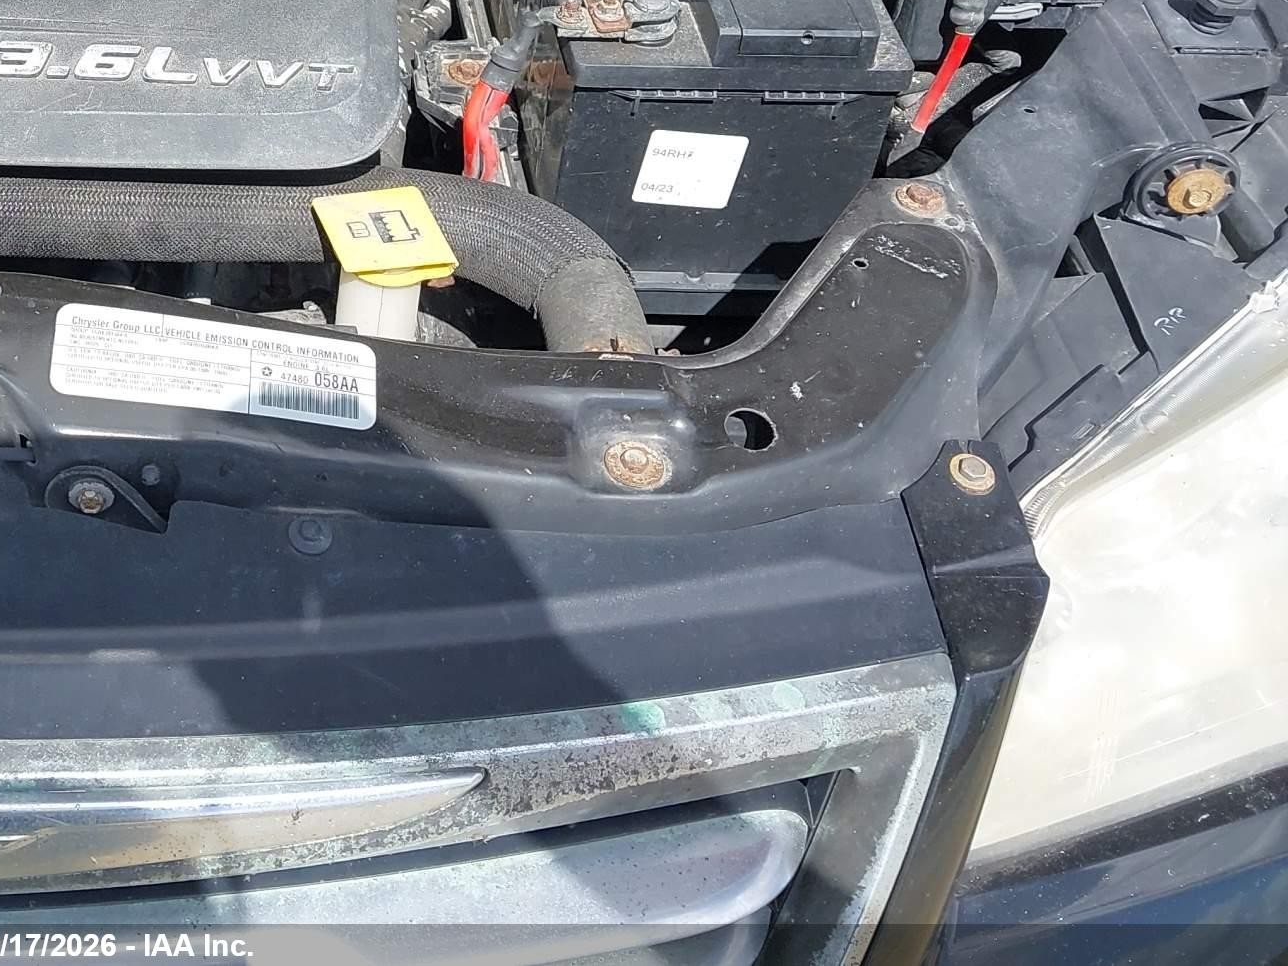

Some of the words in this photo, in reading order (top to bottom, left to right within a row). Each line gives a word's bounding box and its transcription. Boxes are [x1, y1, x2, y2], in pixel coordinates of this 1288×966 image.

[640, 182, 675, 194] 04/23
[71, 315, 110, 332] Chrysler
[112, 319, 141, 335] Group
[143, 322, 161, 335] LLC
[164, 325, 203, 341] VEHICLE
[205, 331, 249, 348] EMISSION
[251, 337, 294, 354] CONTROL
[296, 344, 360, 364] INFORMATION
[313, 370, 360, 393] 058AA
